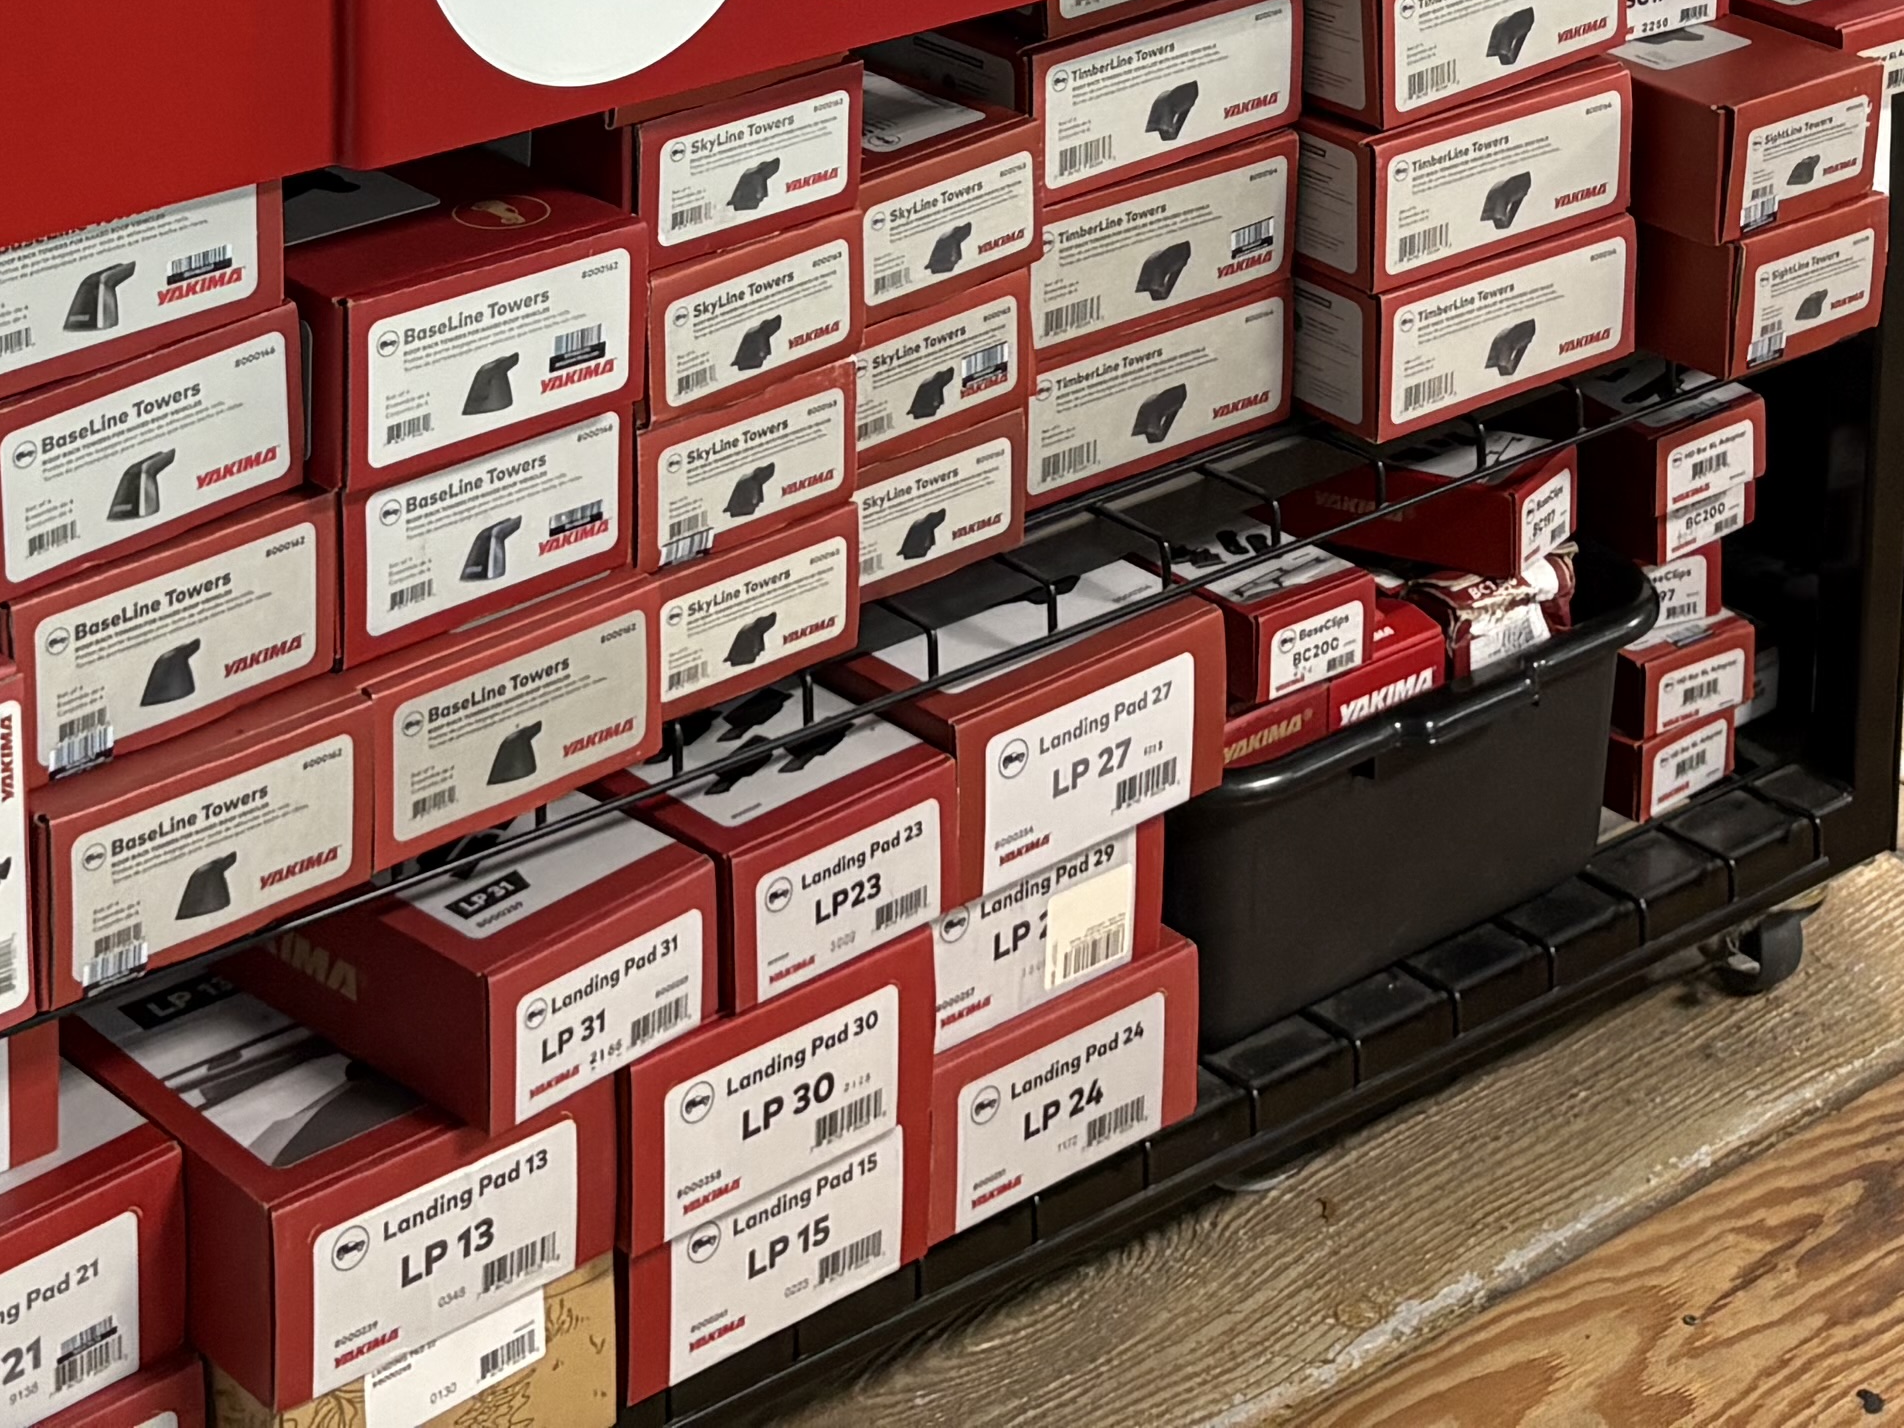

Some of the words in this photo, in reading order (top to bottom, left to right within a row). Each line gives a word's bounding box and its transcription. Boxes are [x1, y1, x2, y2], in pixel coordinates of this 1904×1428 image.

[691, 125, 743, 155] SkyLine
[747, 113, 795, 139] Towers
[403, 303, 485, 349] BaseLine
[488, 287, 551, 324] Towers
[539, 357, 616, 394] YAKIMA
[41, 398, 131, 457] BaseLine
[135, 379, 202, 423] Towers
[1293, 637, 1340, 668] BC200
[1038, 712, 1108, 756] Landing
[1112, 694, 1147, 730] Pad
[1151, 680, 1173, 706] 27
[1339, 668, 1434, 728] YAKIMA
[1052, 759, 1089, 799] LP
[1096, 737, 1134, 778] 27
[814, 873, 883, 926] LP23
[740, 1096, 785, 1142] LP
[792, 1073, 835, 1116] 30
[1022, 1100, 1062, 1142] LP
[1067, 1080, 1104, 1120] 24
[382, 1191, 474, 1242] Landing
[478, 1165, 523, 1203] Pad
[527, 1148, 550, 1177] 13
[401, 1238, 450, 1290] LP
[456, 1218, 496, 1263] 13
